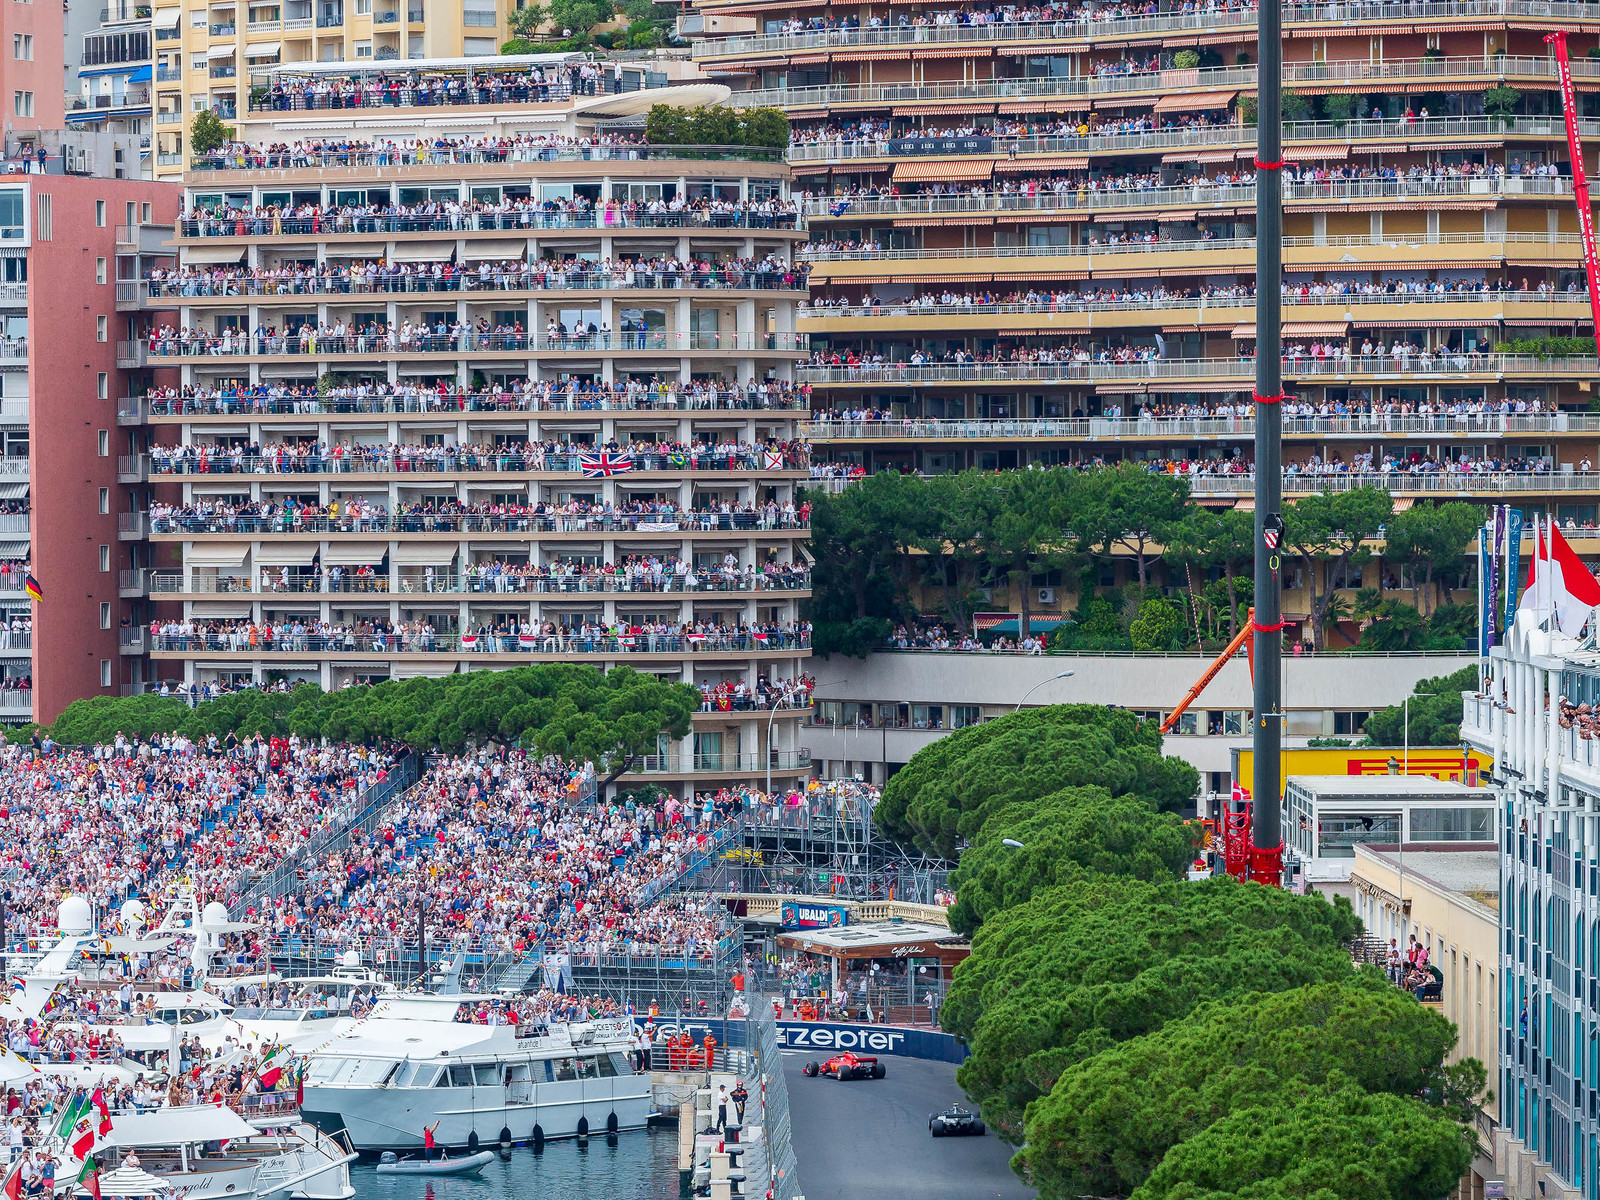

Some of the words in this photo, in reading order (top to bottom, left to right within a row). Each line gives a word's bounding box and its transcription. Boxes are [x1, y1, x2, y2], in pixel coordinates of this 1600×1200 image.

[1564, 61, 1574, 113] IMPERIAL
[1572, 117, 1581, 156] LEVAGE
[1585, 205, 1598, 265] IMPERIAL
[799, 908, 828, 922] UBALDI
[793, 1027, 905, 1050] zepter
